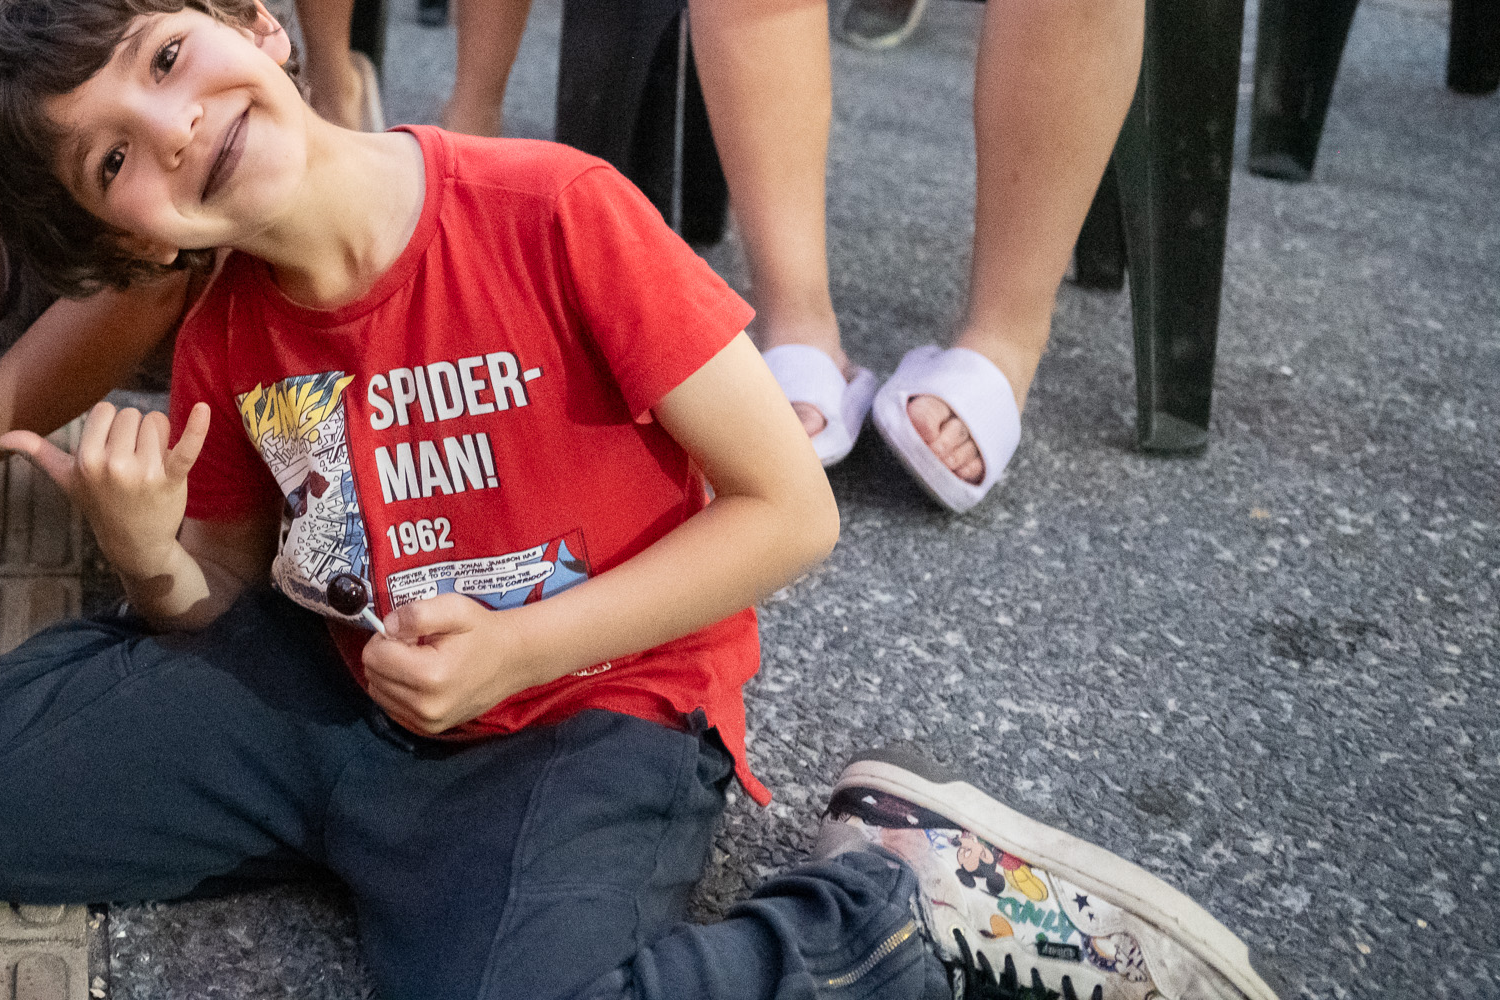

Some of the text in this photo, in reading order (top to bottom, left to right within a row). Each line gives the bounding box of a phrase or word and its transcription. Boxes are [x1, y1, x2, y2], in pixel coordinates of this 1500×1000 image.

[367, 351, 543, 431] SPIDER-
[374, 432, 499, 504] MAN!
[386, 517, 454, 559] 1962
[428, 564, 455, 574] BEFORE
[399, 576, 426, 587] CHANCE
[429, 572, 438, 580] TO
[472, 577, 493, 585] CAME
[496, 574, 516, 582] FROM
[518, 570, 531, 578] THE
[488, 582, 504, 590] THIS
[394, 592, 410, 601] THAT
[412, 588, 427, 596] WAS
